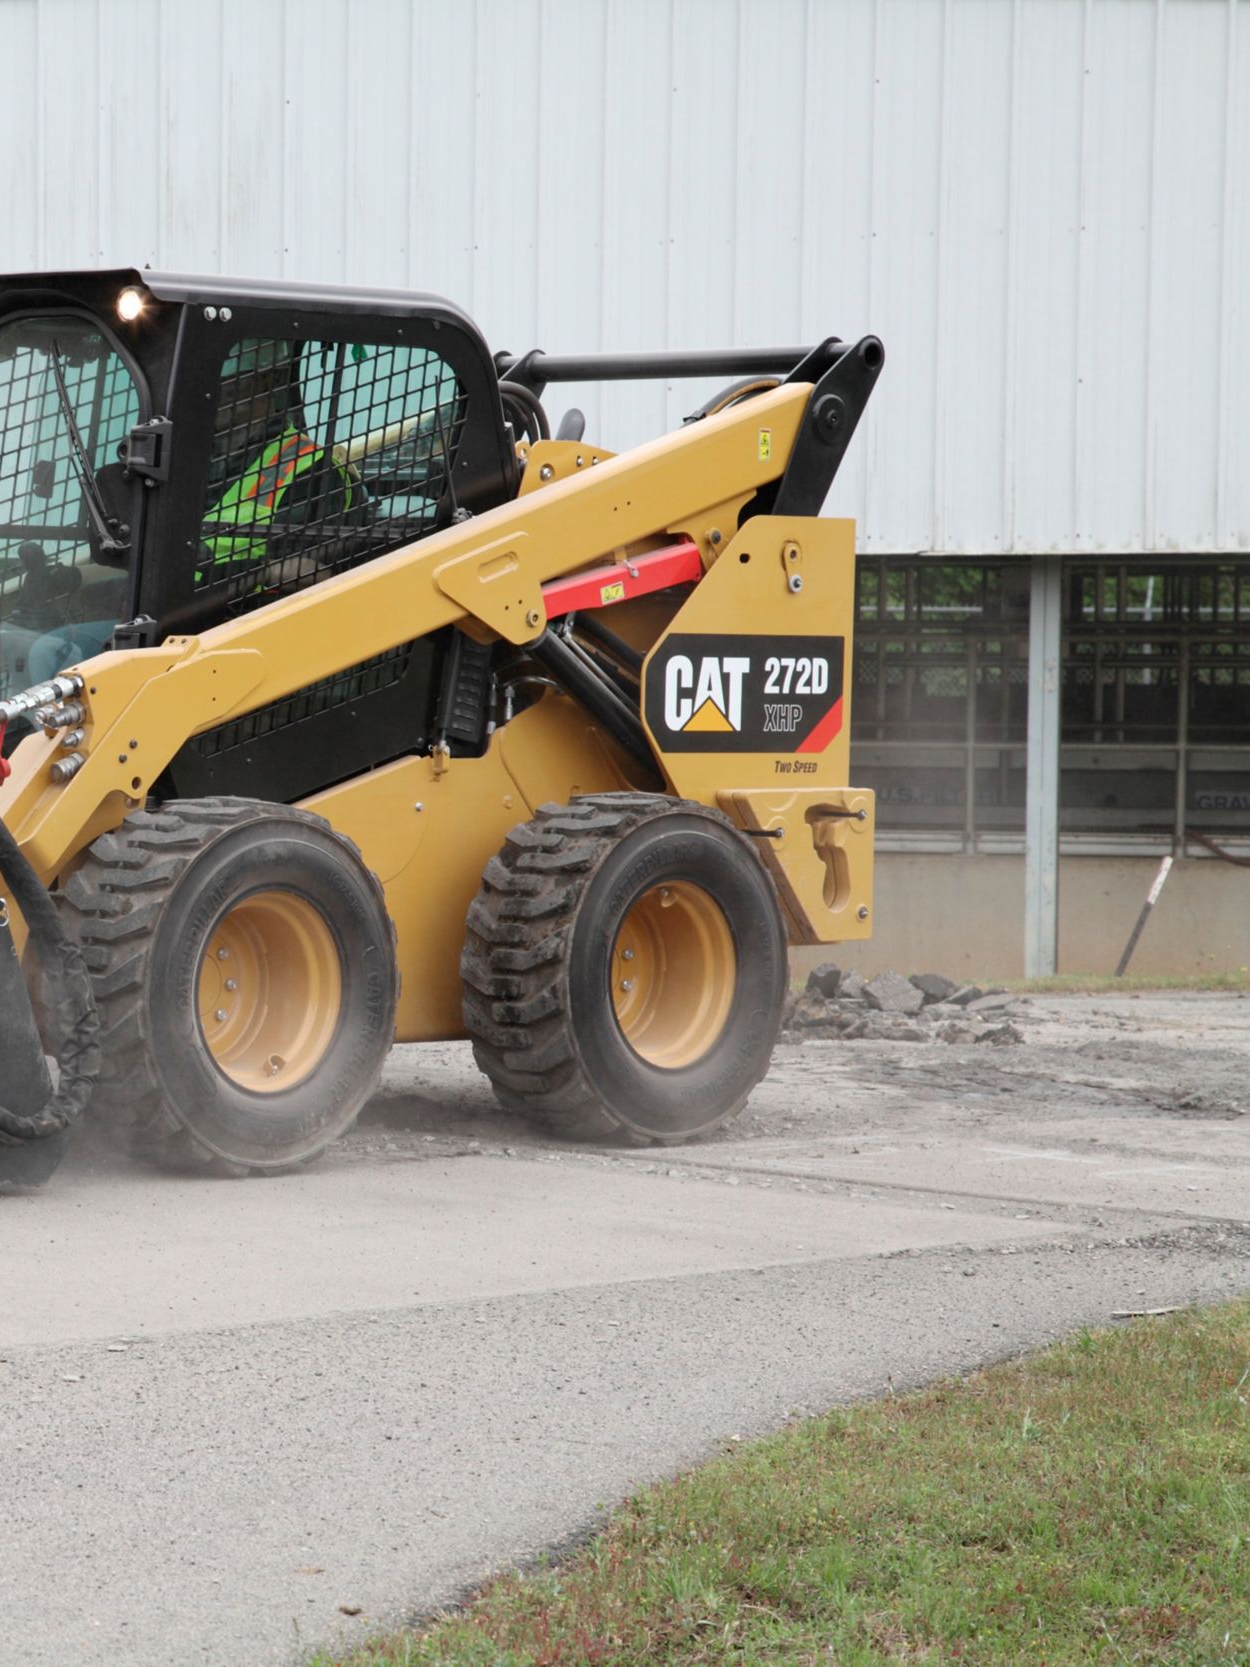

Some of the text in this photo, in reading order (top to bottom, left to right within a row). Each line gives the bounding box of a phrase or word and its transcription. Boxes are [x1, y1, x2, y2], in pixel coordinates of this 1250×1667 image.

[664, 654, 750, 732] CAT
[763, 656, 830, 695] 272D
[763, 704, 803, 732] XHP
